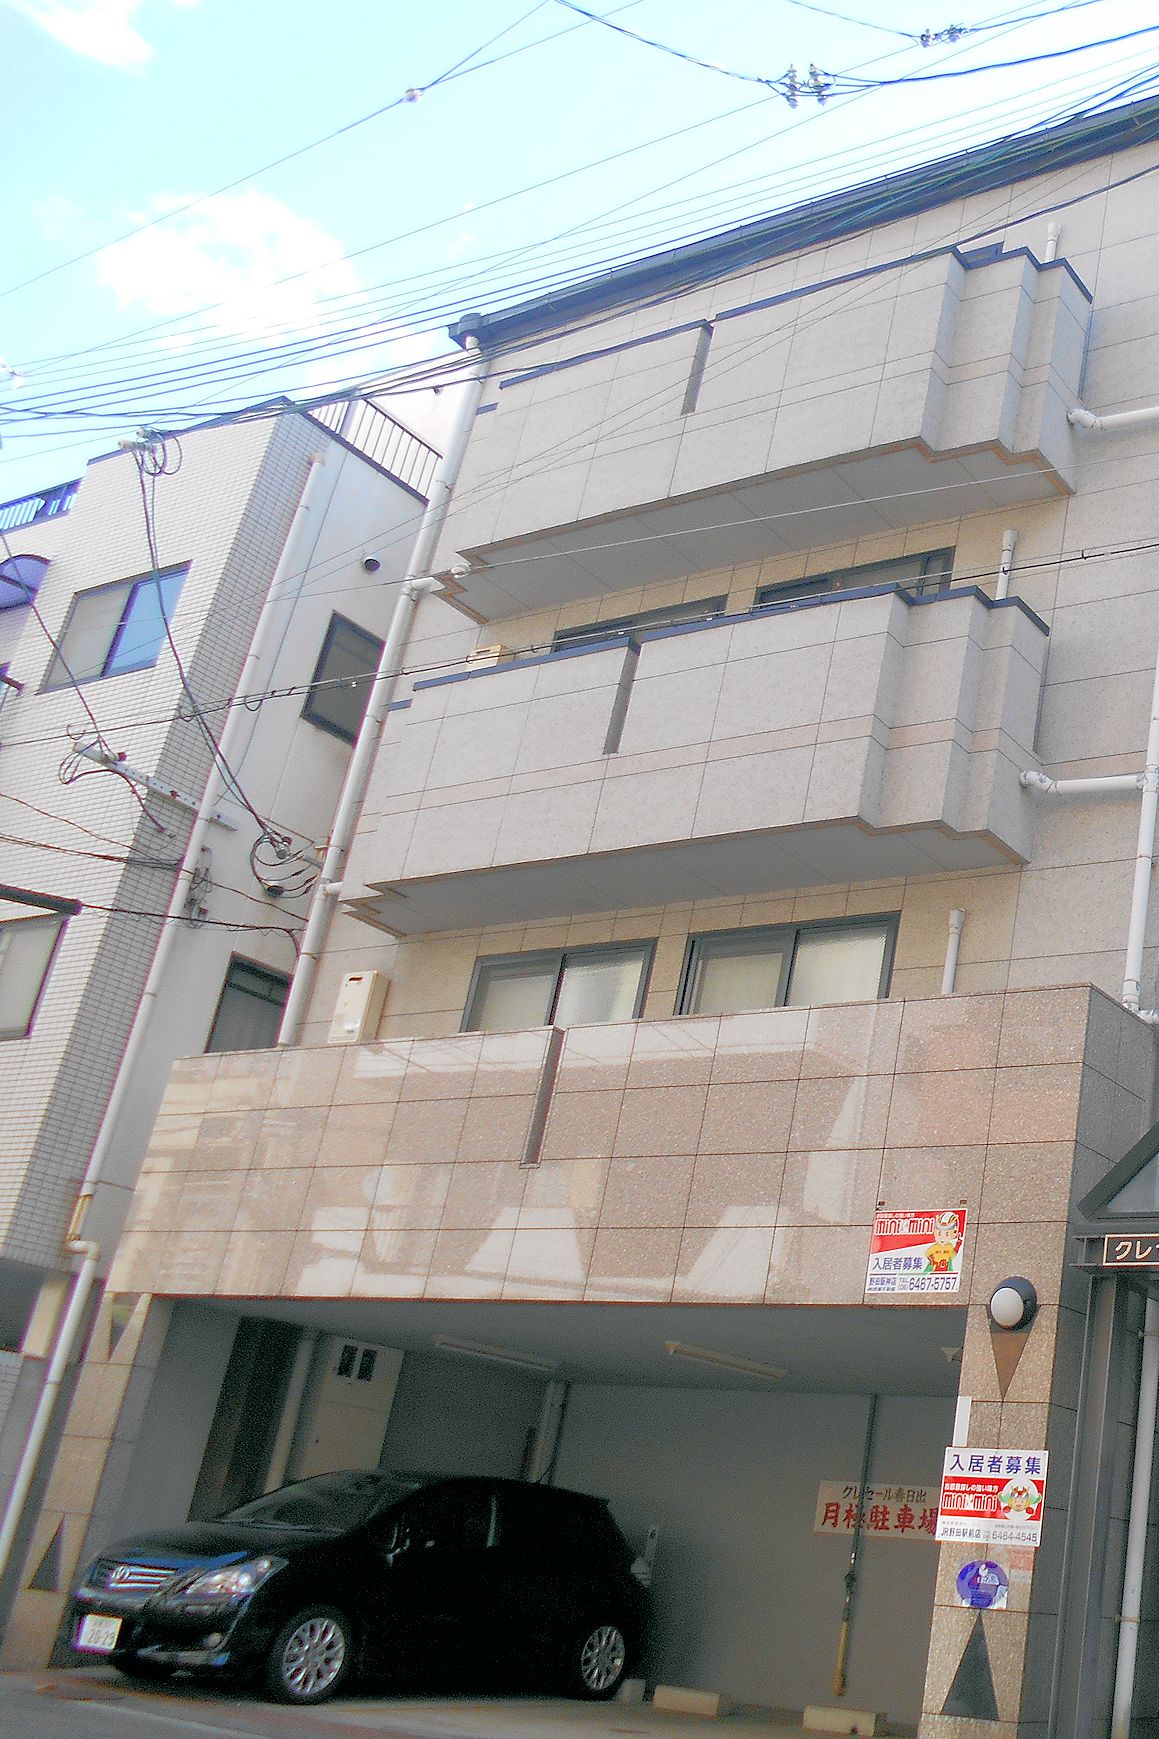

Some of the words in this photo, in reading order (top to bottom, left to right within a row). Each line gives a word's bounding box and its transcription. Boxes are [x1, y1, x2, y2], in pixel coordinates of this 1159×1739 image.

[872, 1257, 923, 1271] 入居者募集
[950, 1453, 1041, 1475] 入居者募集
